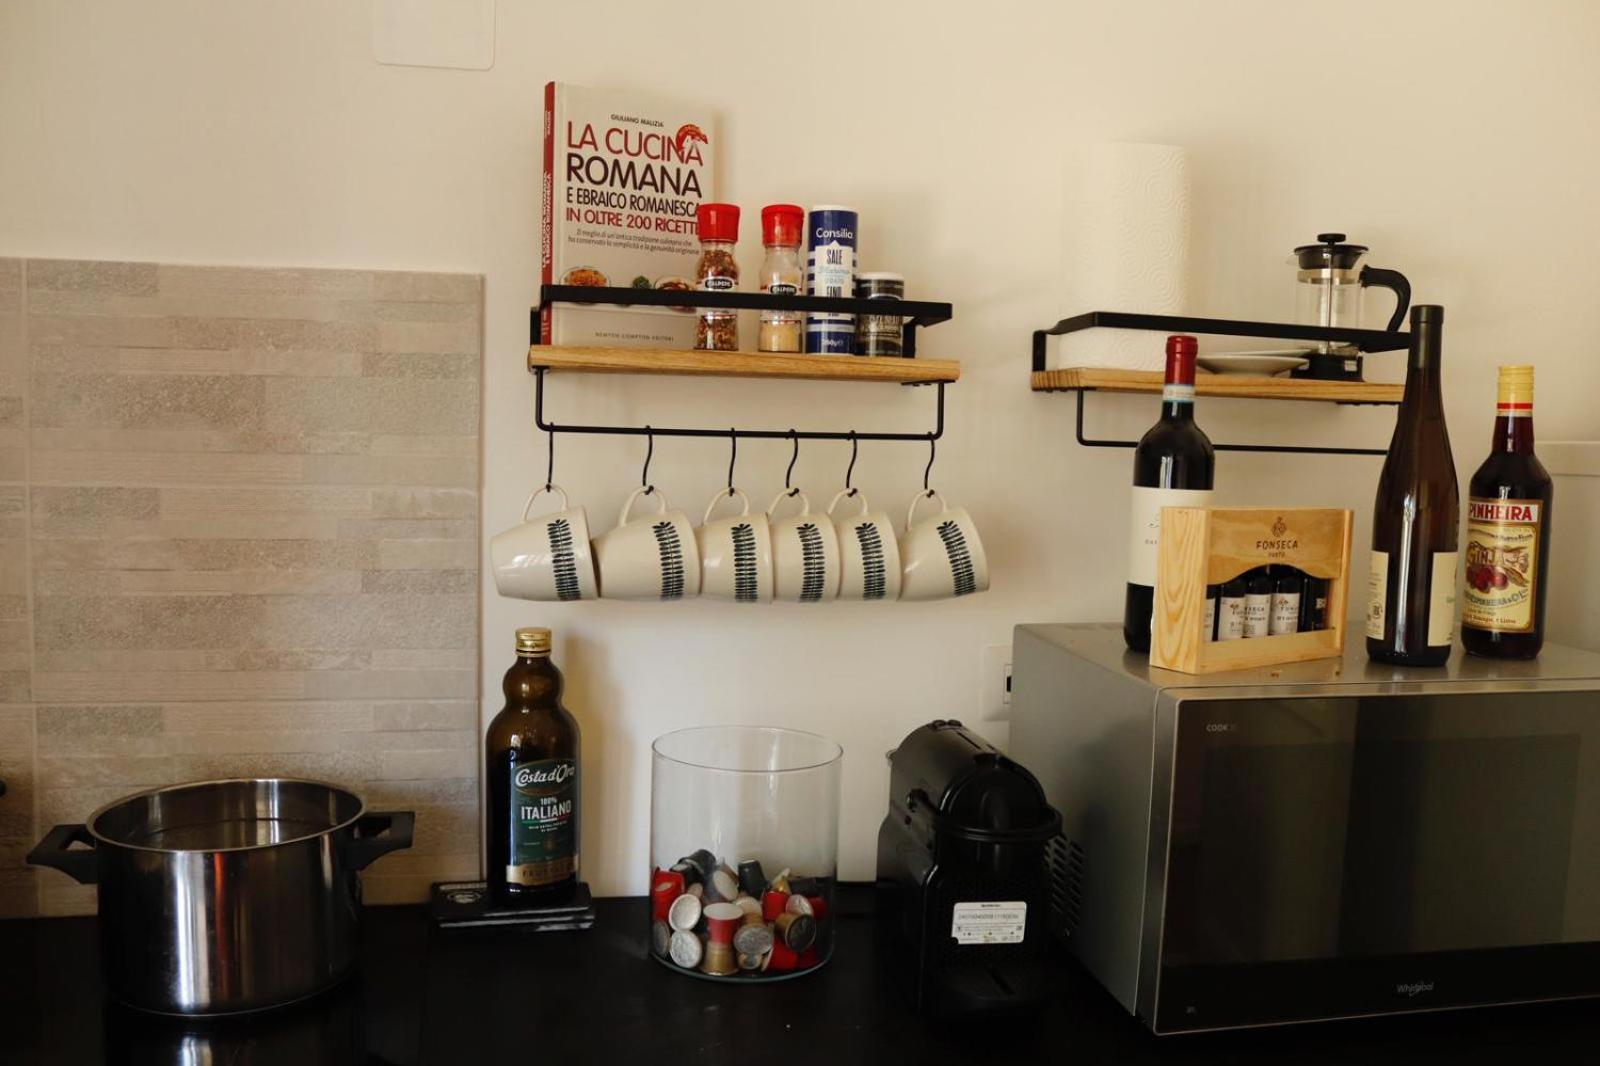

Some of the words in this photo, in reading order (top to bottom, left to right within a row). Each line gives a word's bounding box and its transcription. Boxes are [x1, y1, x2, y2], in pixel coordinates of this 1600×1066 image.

[610, 113, 640, 124] GIULIANO
[640, 117, 664, 128] MALIZIA
[567, 121, 599, 152] LA
[605, 127, 704, 167] CUCINA
[566, 152, 703, 199] ROMANA
[566, 186, 574, 204] E
[576, 188, 627, 210] EBRAICO
[566, 207, 581, 224] IN
[584, 209, 623, 228] OLTRE
[626, 214, 652, 231] 200
[815, 227, 854, 240] Consilia
[826, 249, 843, 266] SALE
[1255, 539, 1299, 551] FONSECA
[515, 767, 546, 788] Costa
[549, 763, 575, 784] d'Oro
[520, 799, 573, 821] ITALIANO
[540, 797, 558, 806] 100%
